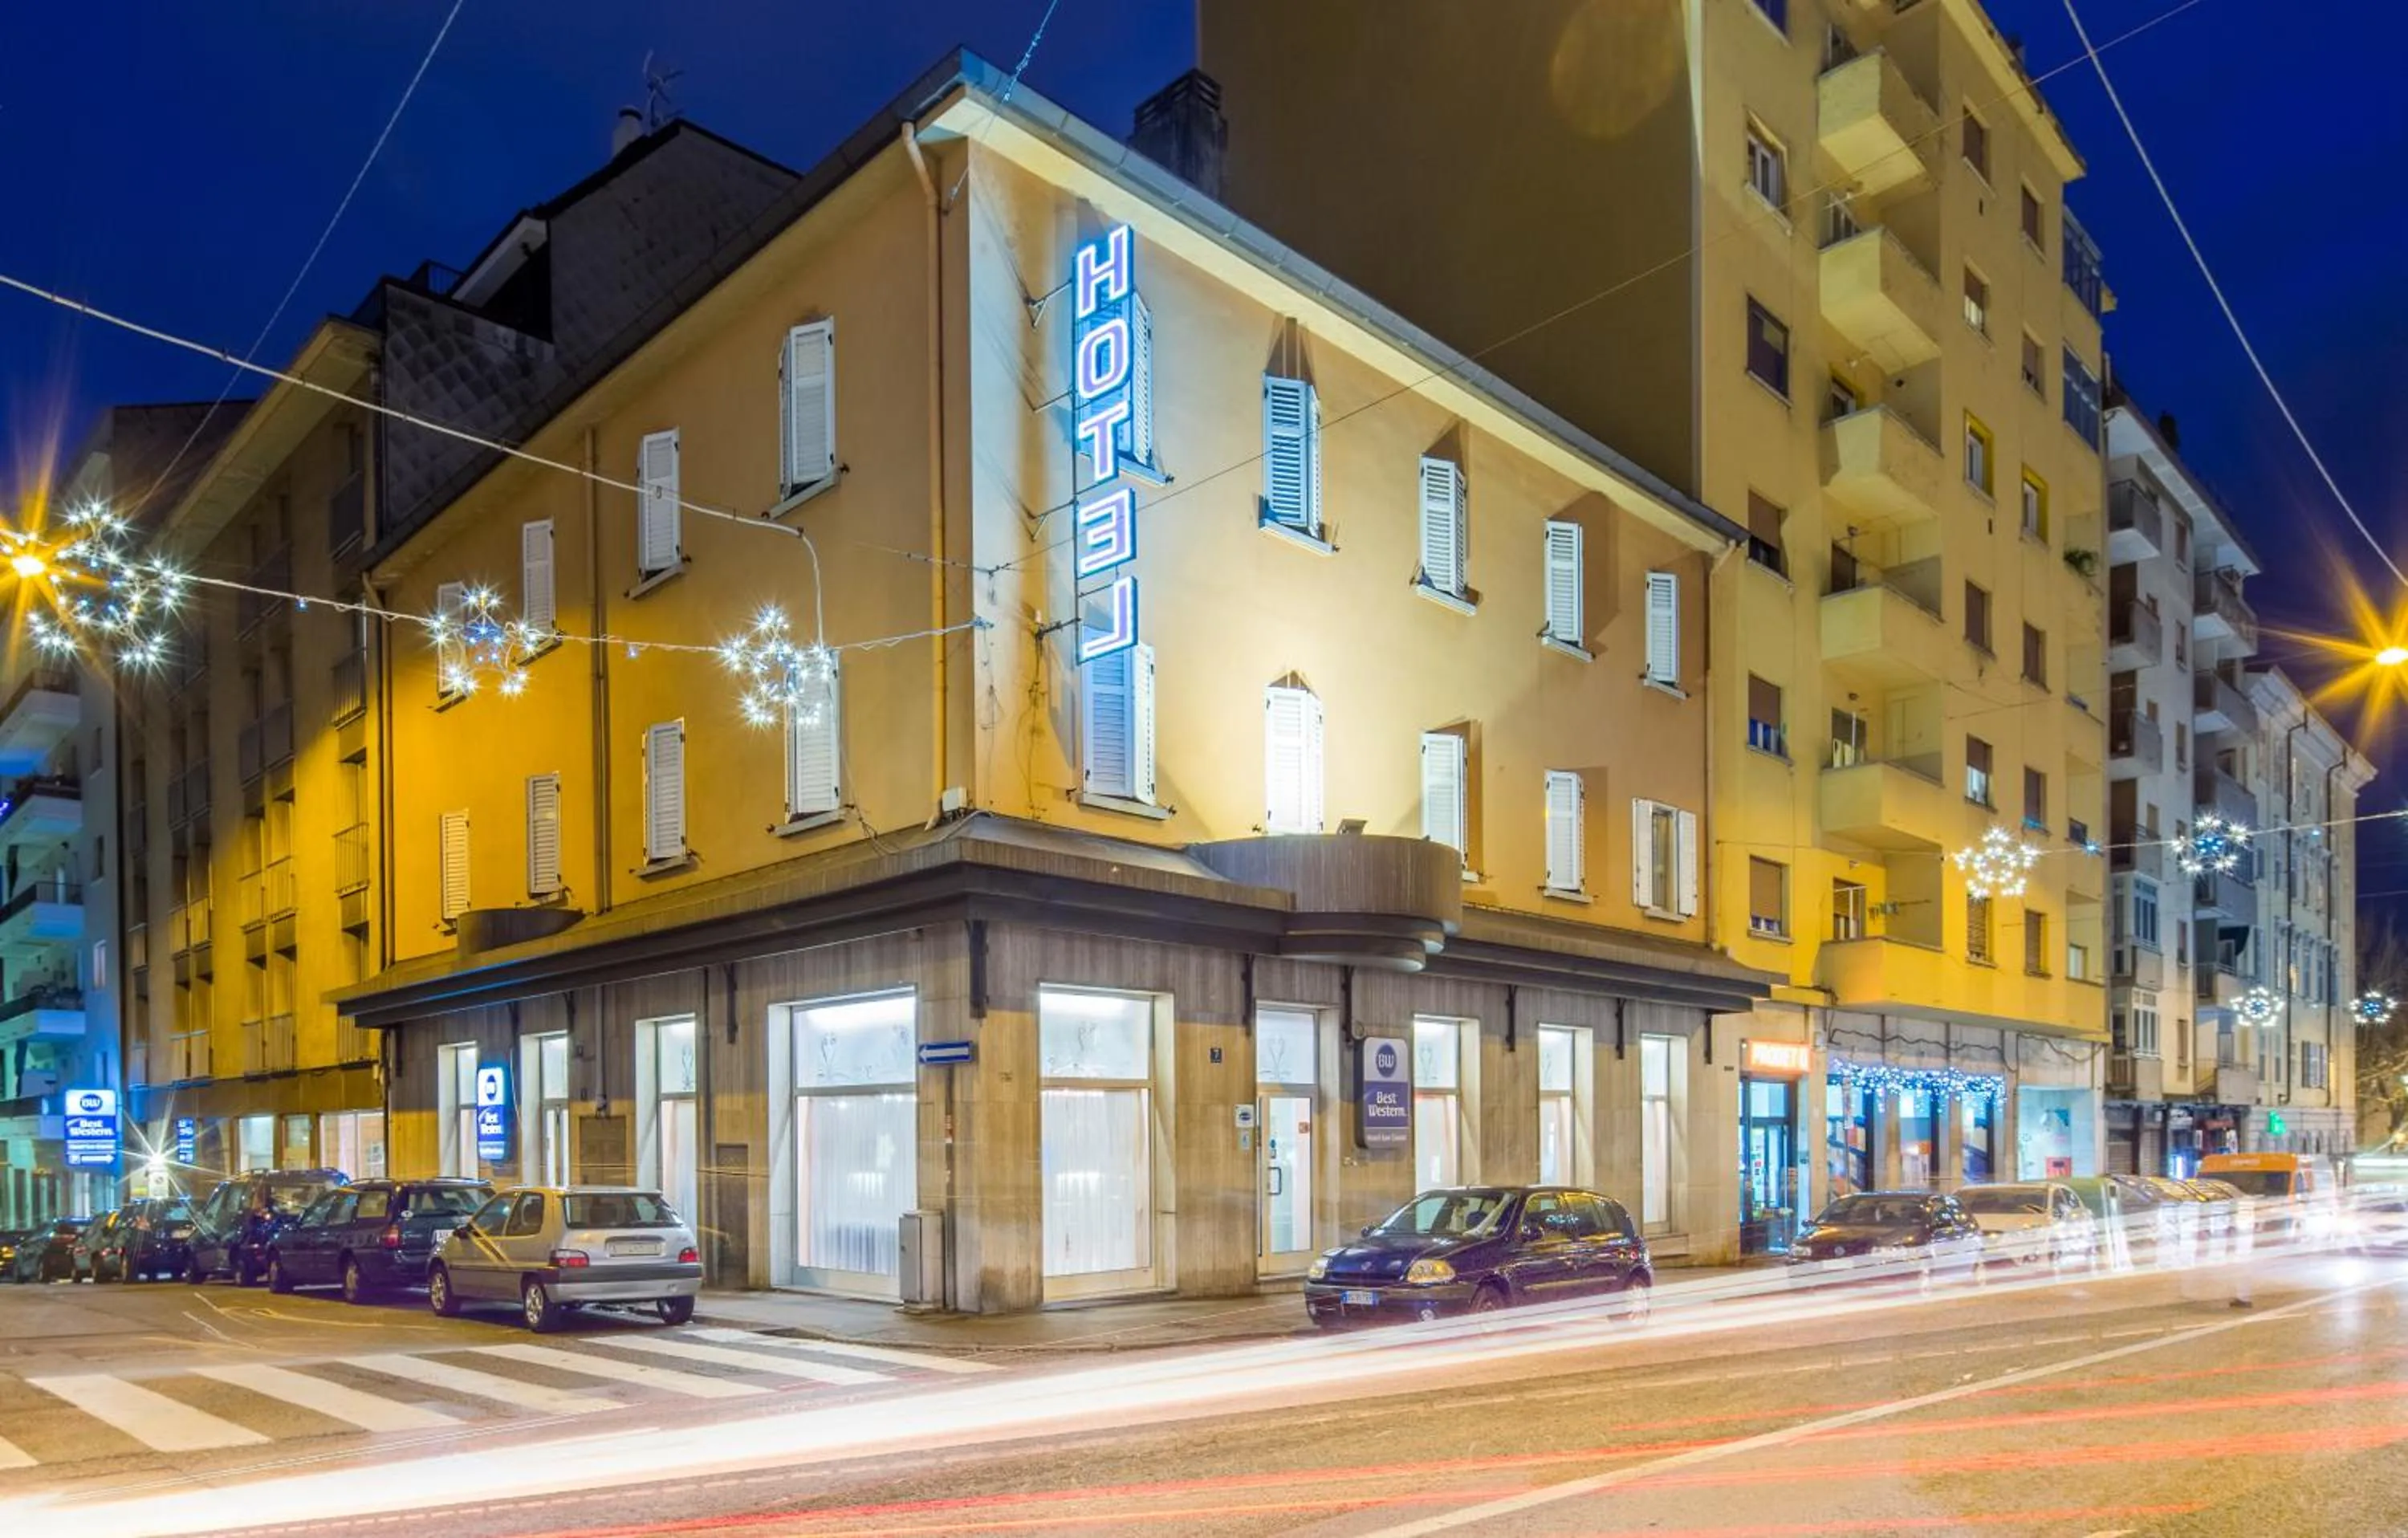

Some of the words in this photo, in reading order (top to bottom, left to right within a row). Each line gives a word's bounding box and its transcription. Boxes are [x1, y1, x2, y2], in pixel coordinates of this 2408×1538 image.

[1377, 1052, 1394, 1068] BW
[1377, 1092, 1397, 1104] Best
[1368, 1105, 1405, 1117] Western
[79, 1119, 104, 1128] Best
